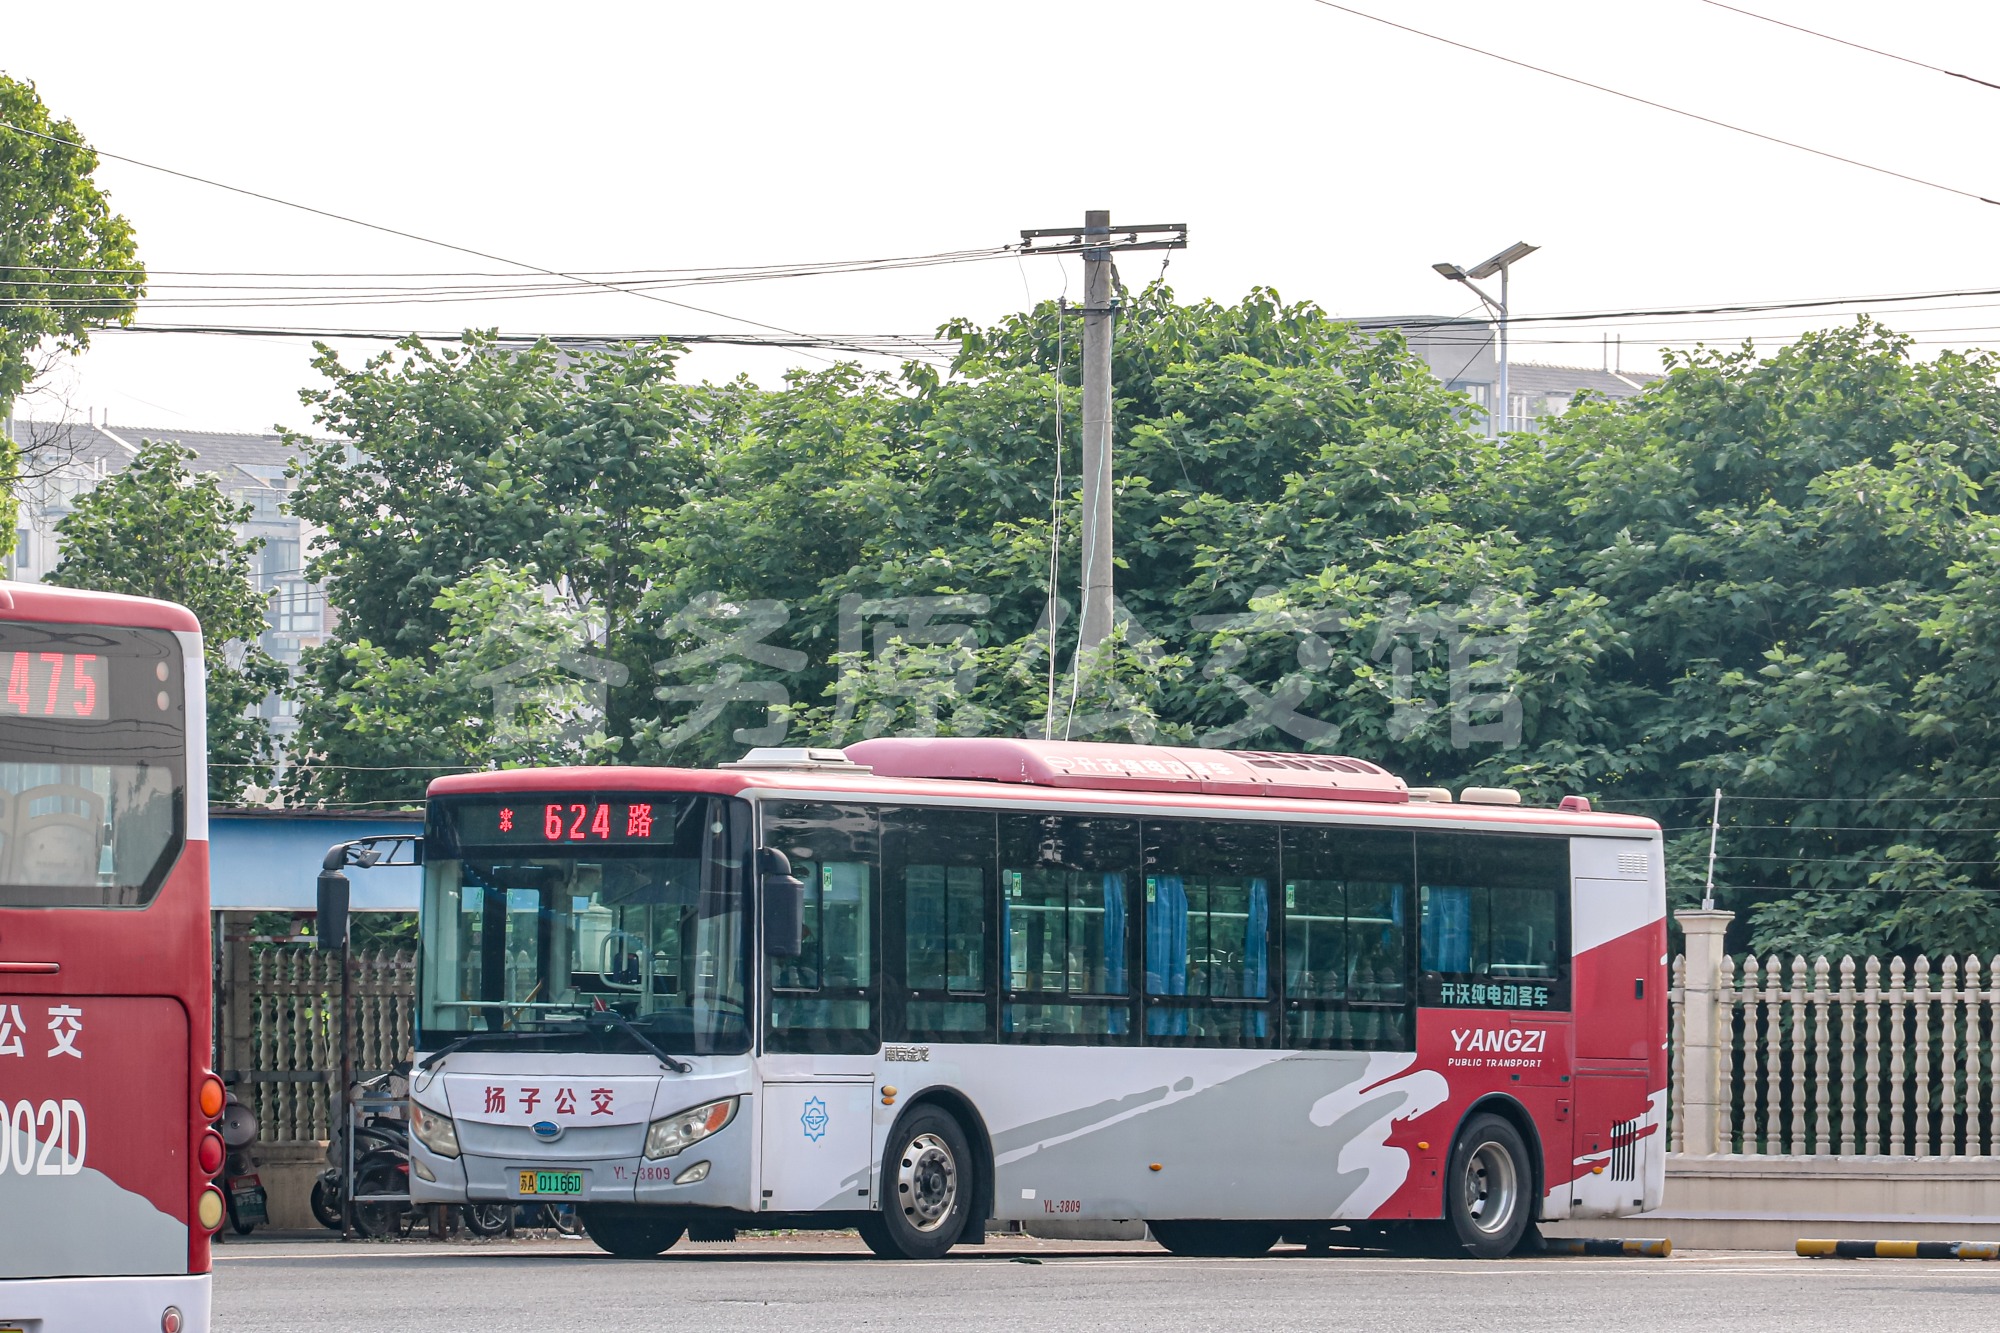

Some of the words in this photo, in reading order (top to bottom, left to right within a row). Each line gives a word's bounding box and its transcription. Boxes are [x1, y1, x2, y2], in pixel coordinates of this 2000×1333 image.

[7, 651, 97, 716] 475
[544, 804, 610, 840] 624
[627, 803, 653, 837] 路
[1440, 983, 1548, 1007] 开沃纯电动客车
[1450, 1028, 1547, 1053] YANGZI
[1447, 1058, 1482, 1067] PUBLIC
[1486, 1058, 1542, 1068] TRANSPORT
[484, 1086, 614, 1116] 扬子公交
[613, 1166, 671, 1181] YL-3809
[1043, 1199, 1081, 1213] YL-3809
